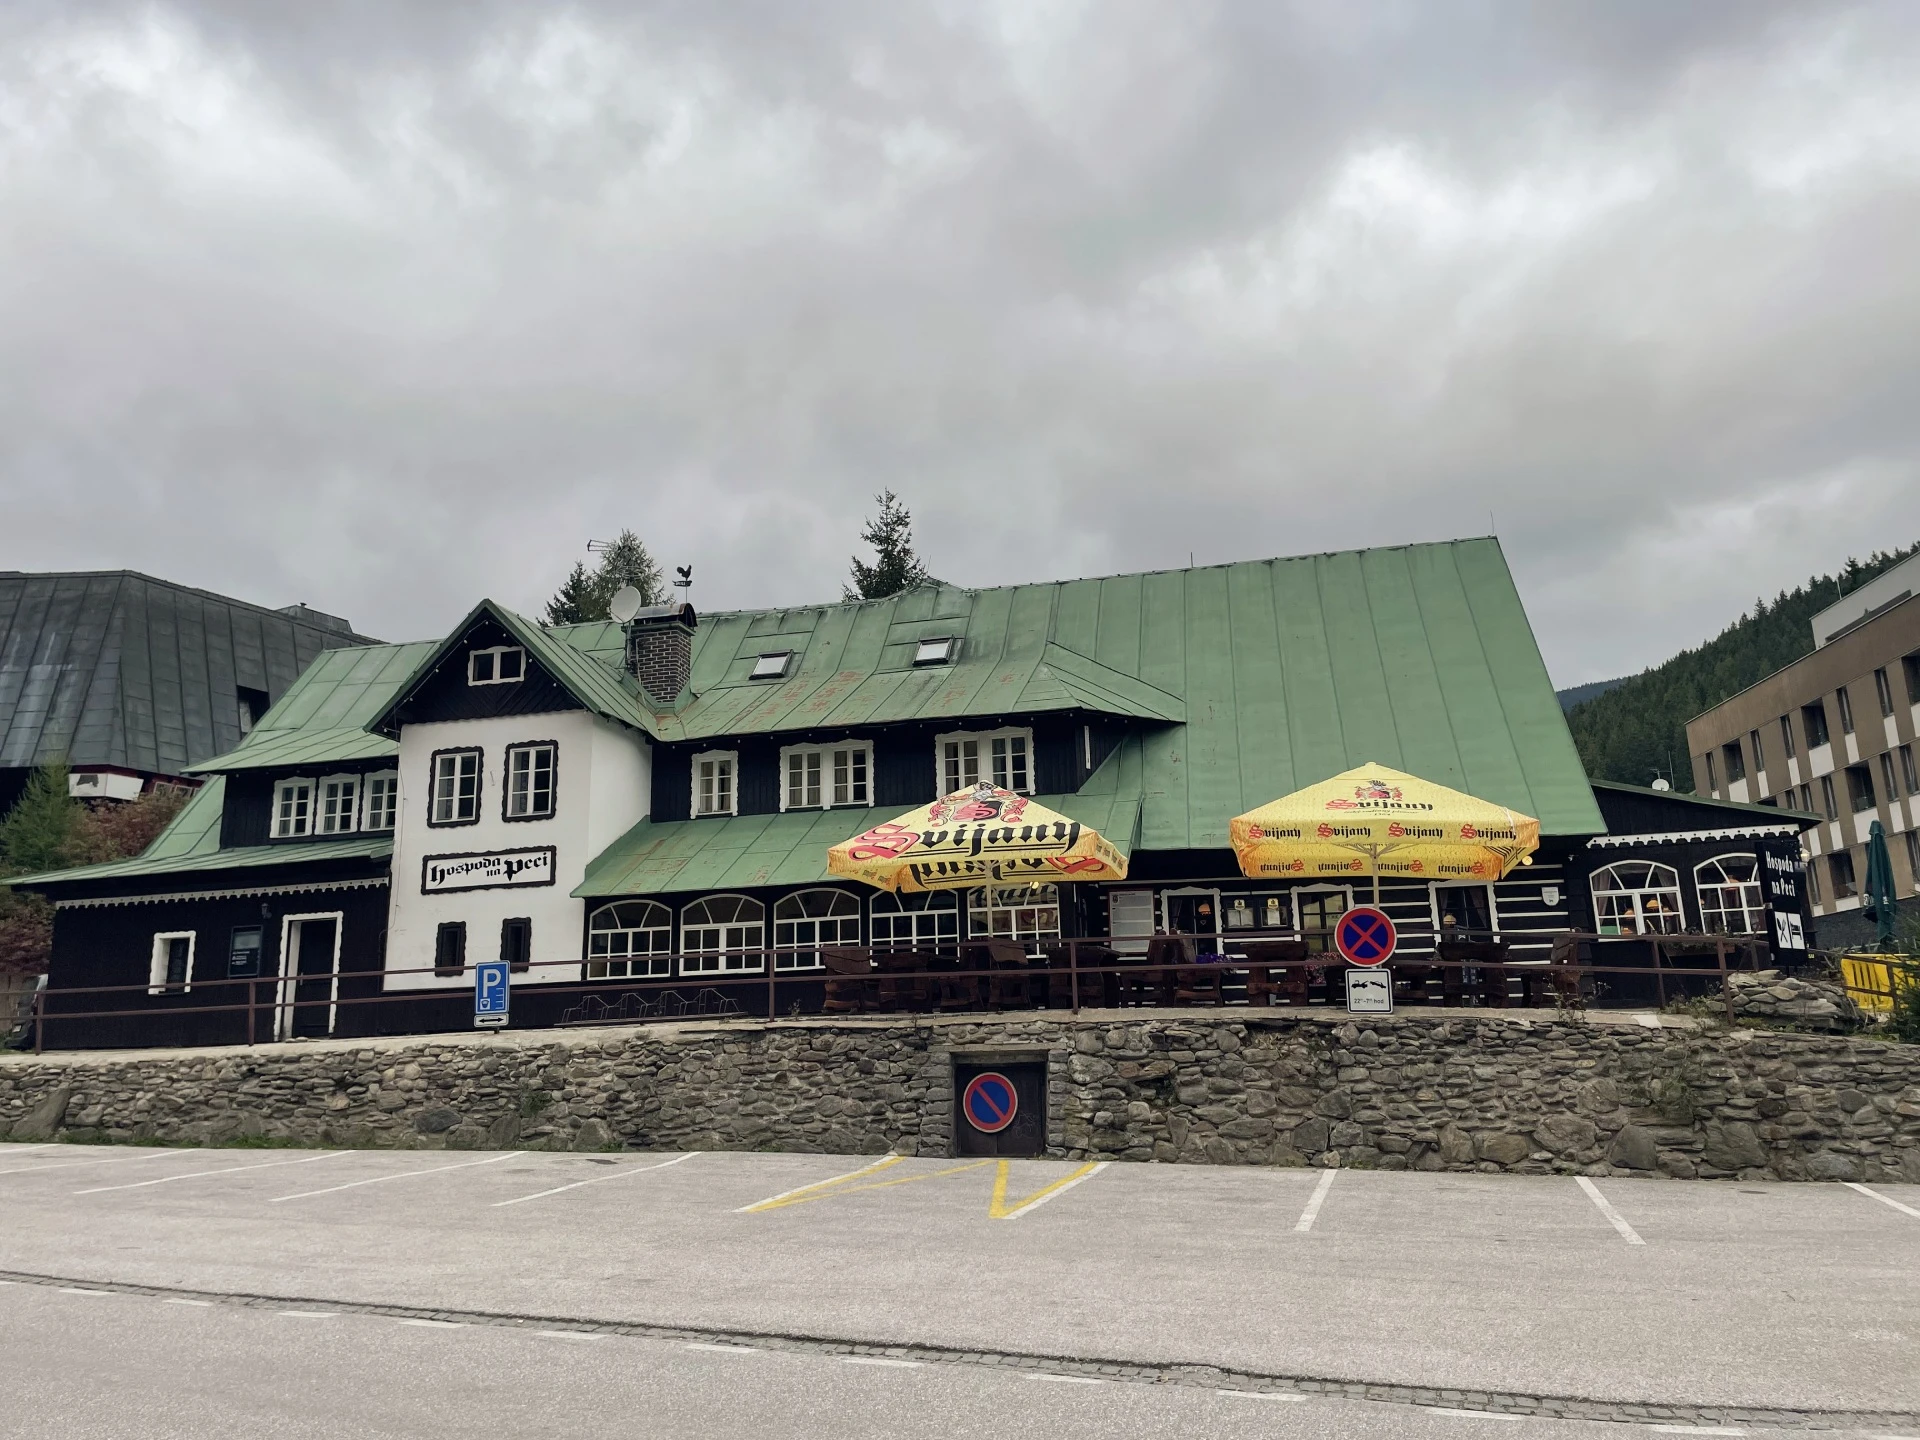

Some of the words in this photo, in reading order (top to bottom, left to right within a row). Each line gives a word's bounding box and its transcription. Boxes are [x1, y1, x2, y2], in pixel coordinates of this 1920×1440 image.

[1325, 798, 1434, 811] Svijany
[1249, 824, 1301, 839] Svijany
[1317, 823, 1371, 839] Svijany
[1388, 822, 1443, 839] Svijany
[848, 821, 1081, 861] Svijany
[1765, 850, 1794, 876] Hospoda
[486, 868, 501, 877] na
[483, 968, 501, 998] P
